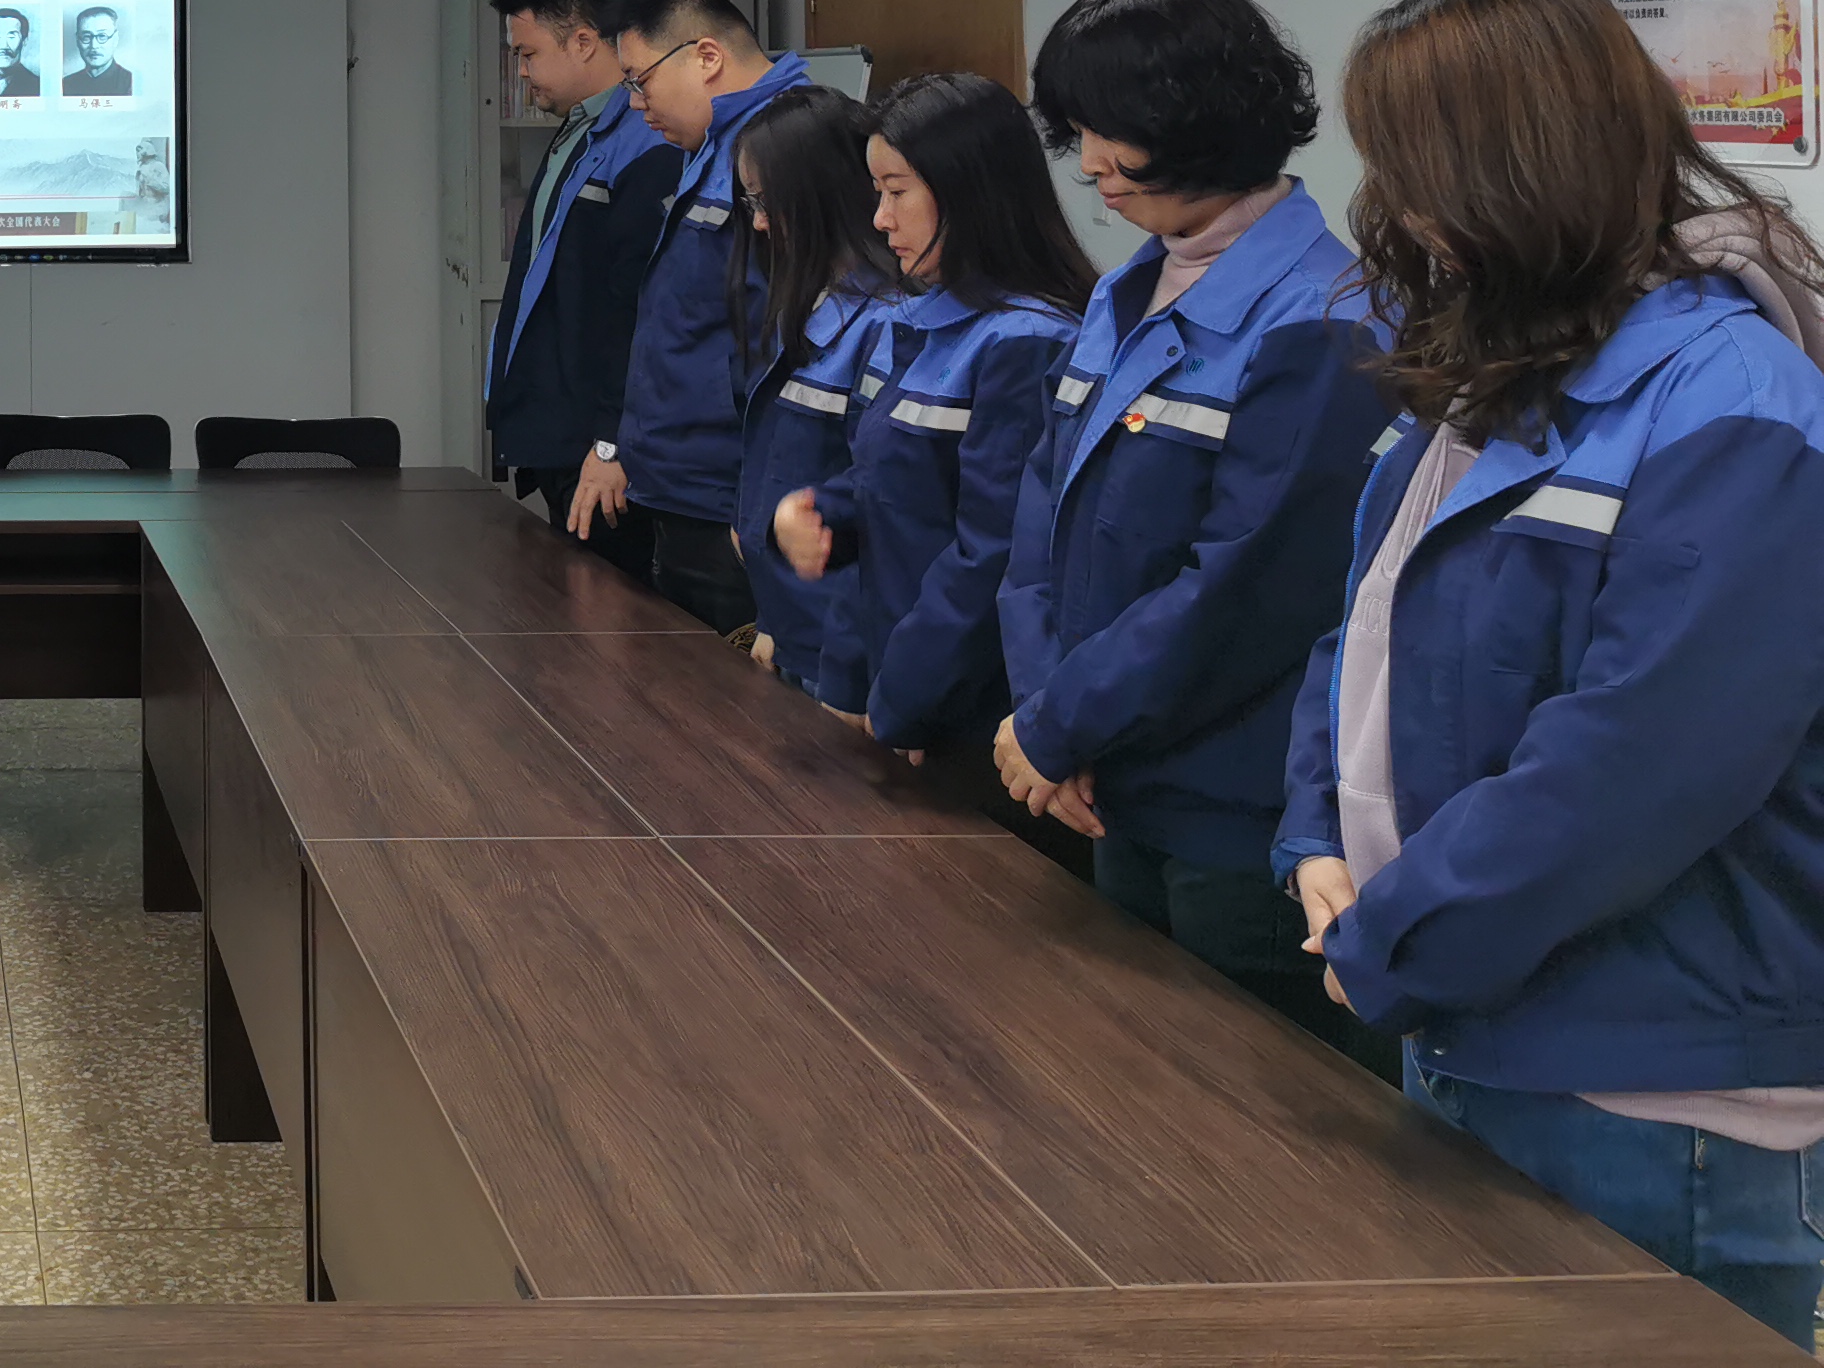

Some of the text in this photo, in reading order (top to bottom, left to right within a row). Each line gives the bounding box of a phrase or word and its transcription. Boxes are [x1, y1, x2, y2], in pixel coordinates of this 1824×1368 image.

[1690, 110, 1783, 123] 水务集团有限公司委员会
